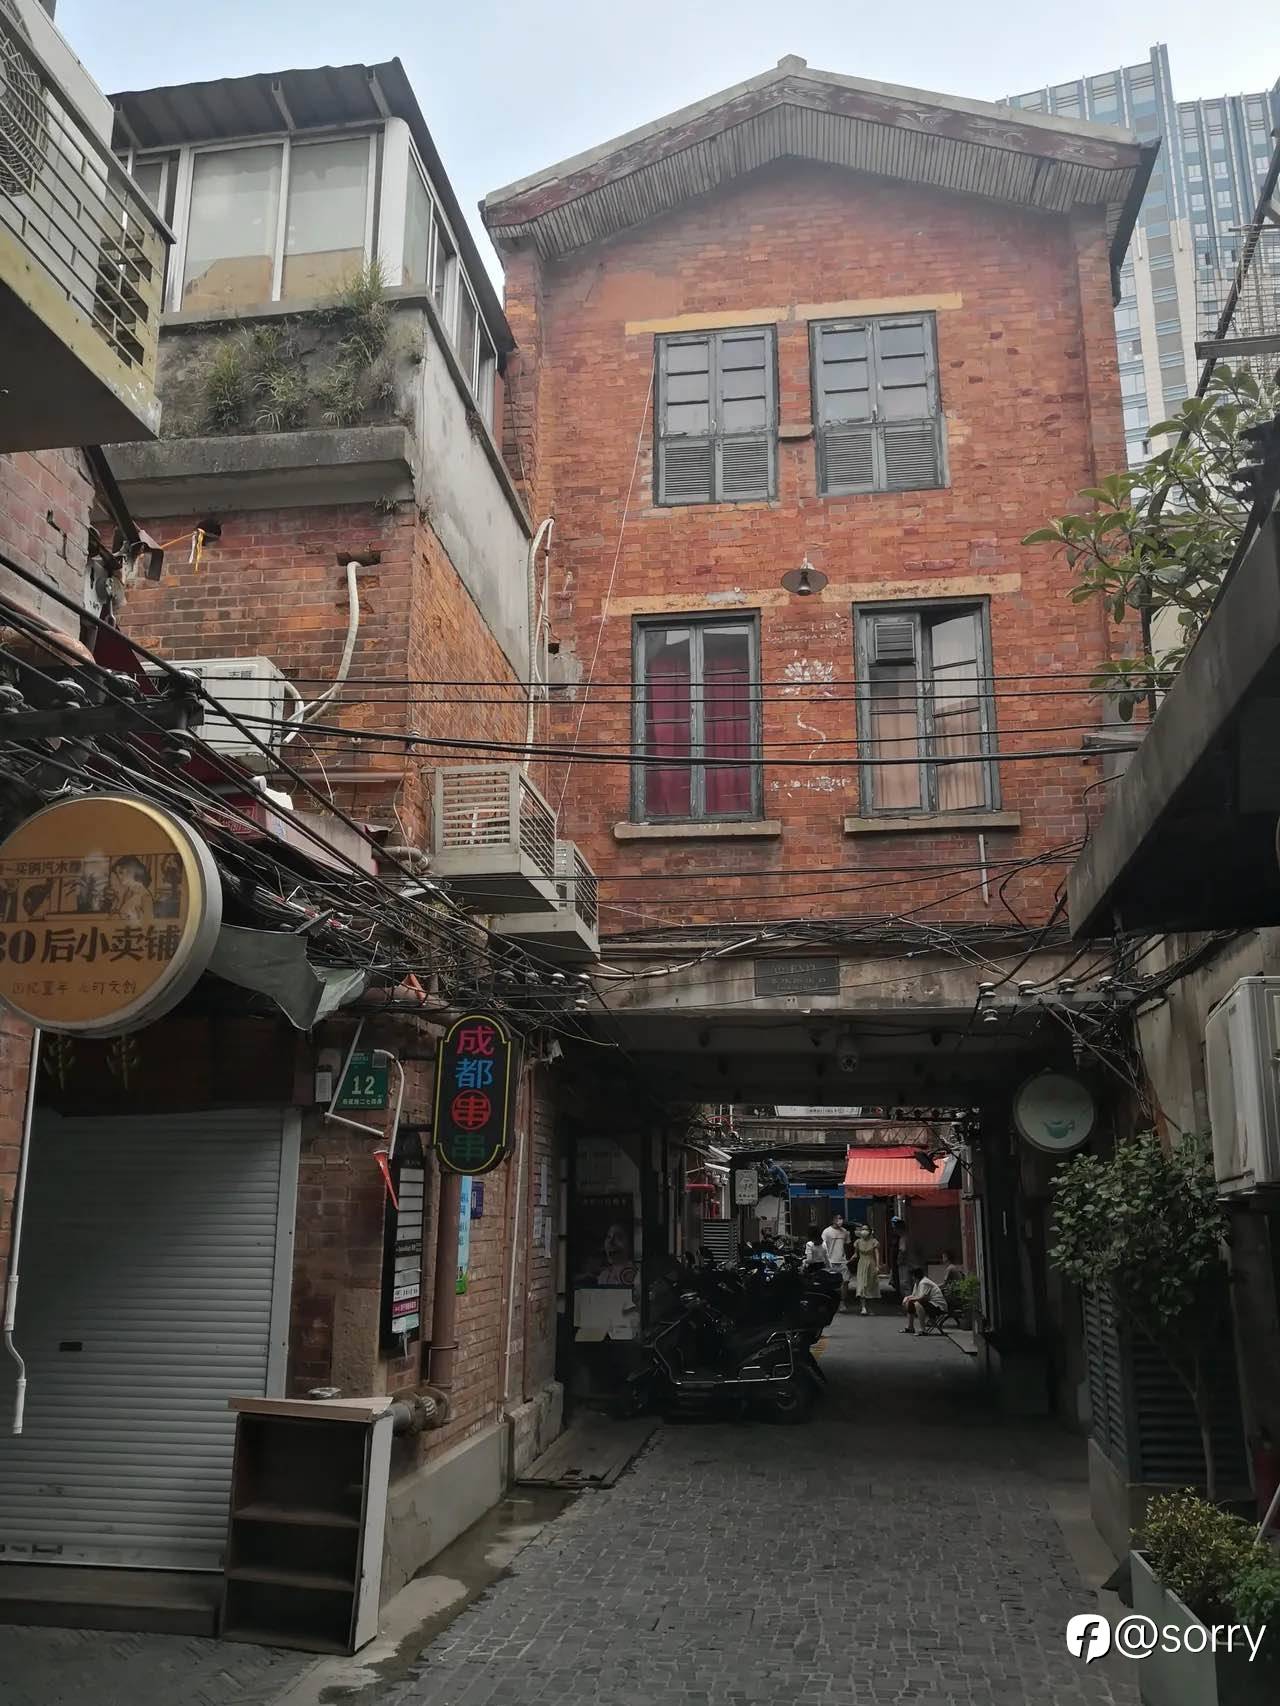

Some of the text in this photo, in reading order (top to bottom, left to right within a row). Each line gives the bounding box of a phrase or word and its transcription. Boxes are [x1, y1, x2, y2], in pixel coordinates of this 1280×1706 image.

[0, 924, 181, 964] 0后小卖铺
[351, 1075, 376, 1095] 12
[451, 1025, 496, 1164] 成都串串
